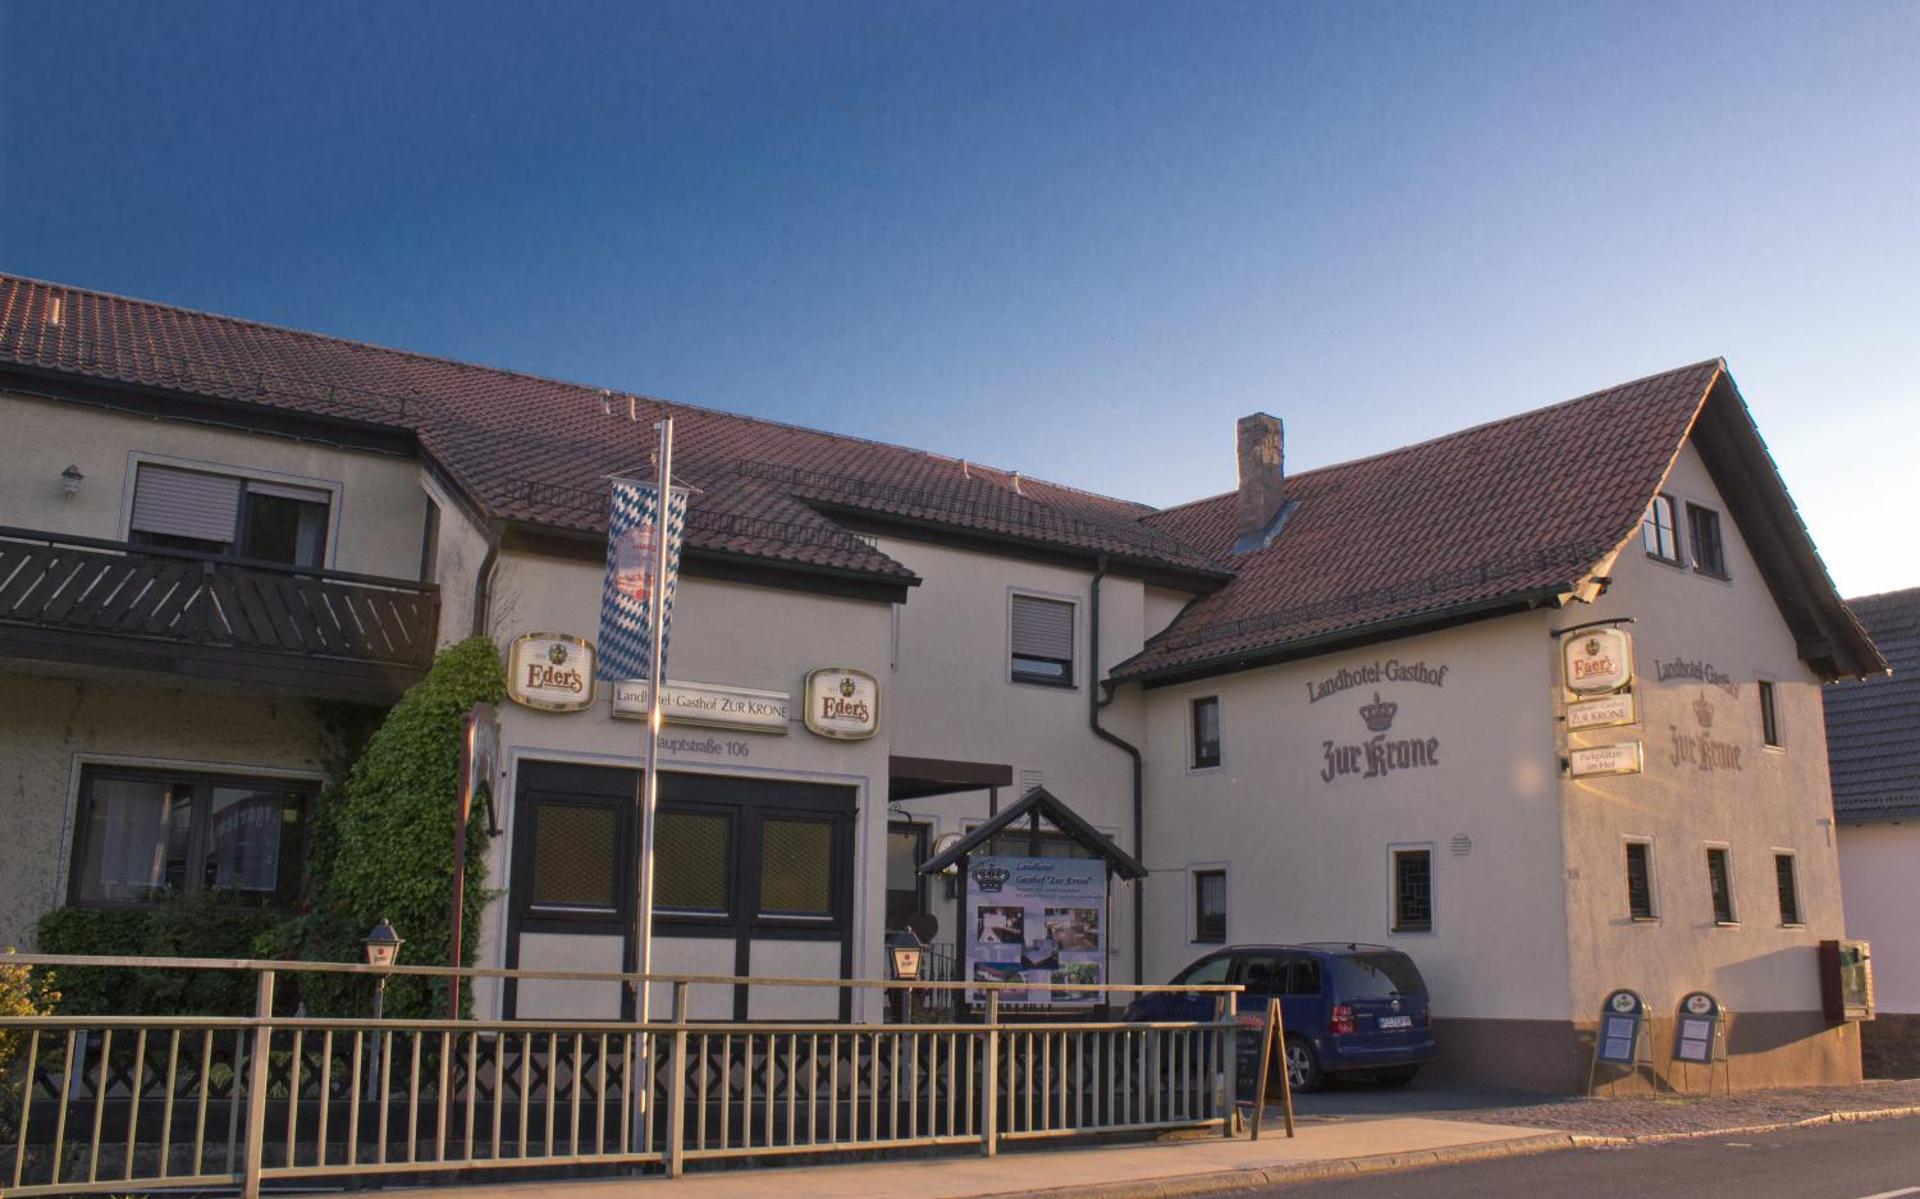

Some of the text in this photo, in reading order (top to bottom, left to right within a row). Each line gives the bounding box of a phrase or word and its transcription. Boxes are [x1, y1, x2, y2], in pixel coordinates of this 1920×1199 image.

[526, 664, 583, 694] Eder's
[721, 698, 746, 714] ZUR
[748, 701, 788, 719] KRONE
[822, 697, 869, 723] Eder's
[725, 741, 750, 757] 106
[1321, 734, 1440, 783] Zur Krone
